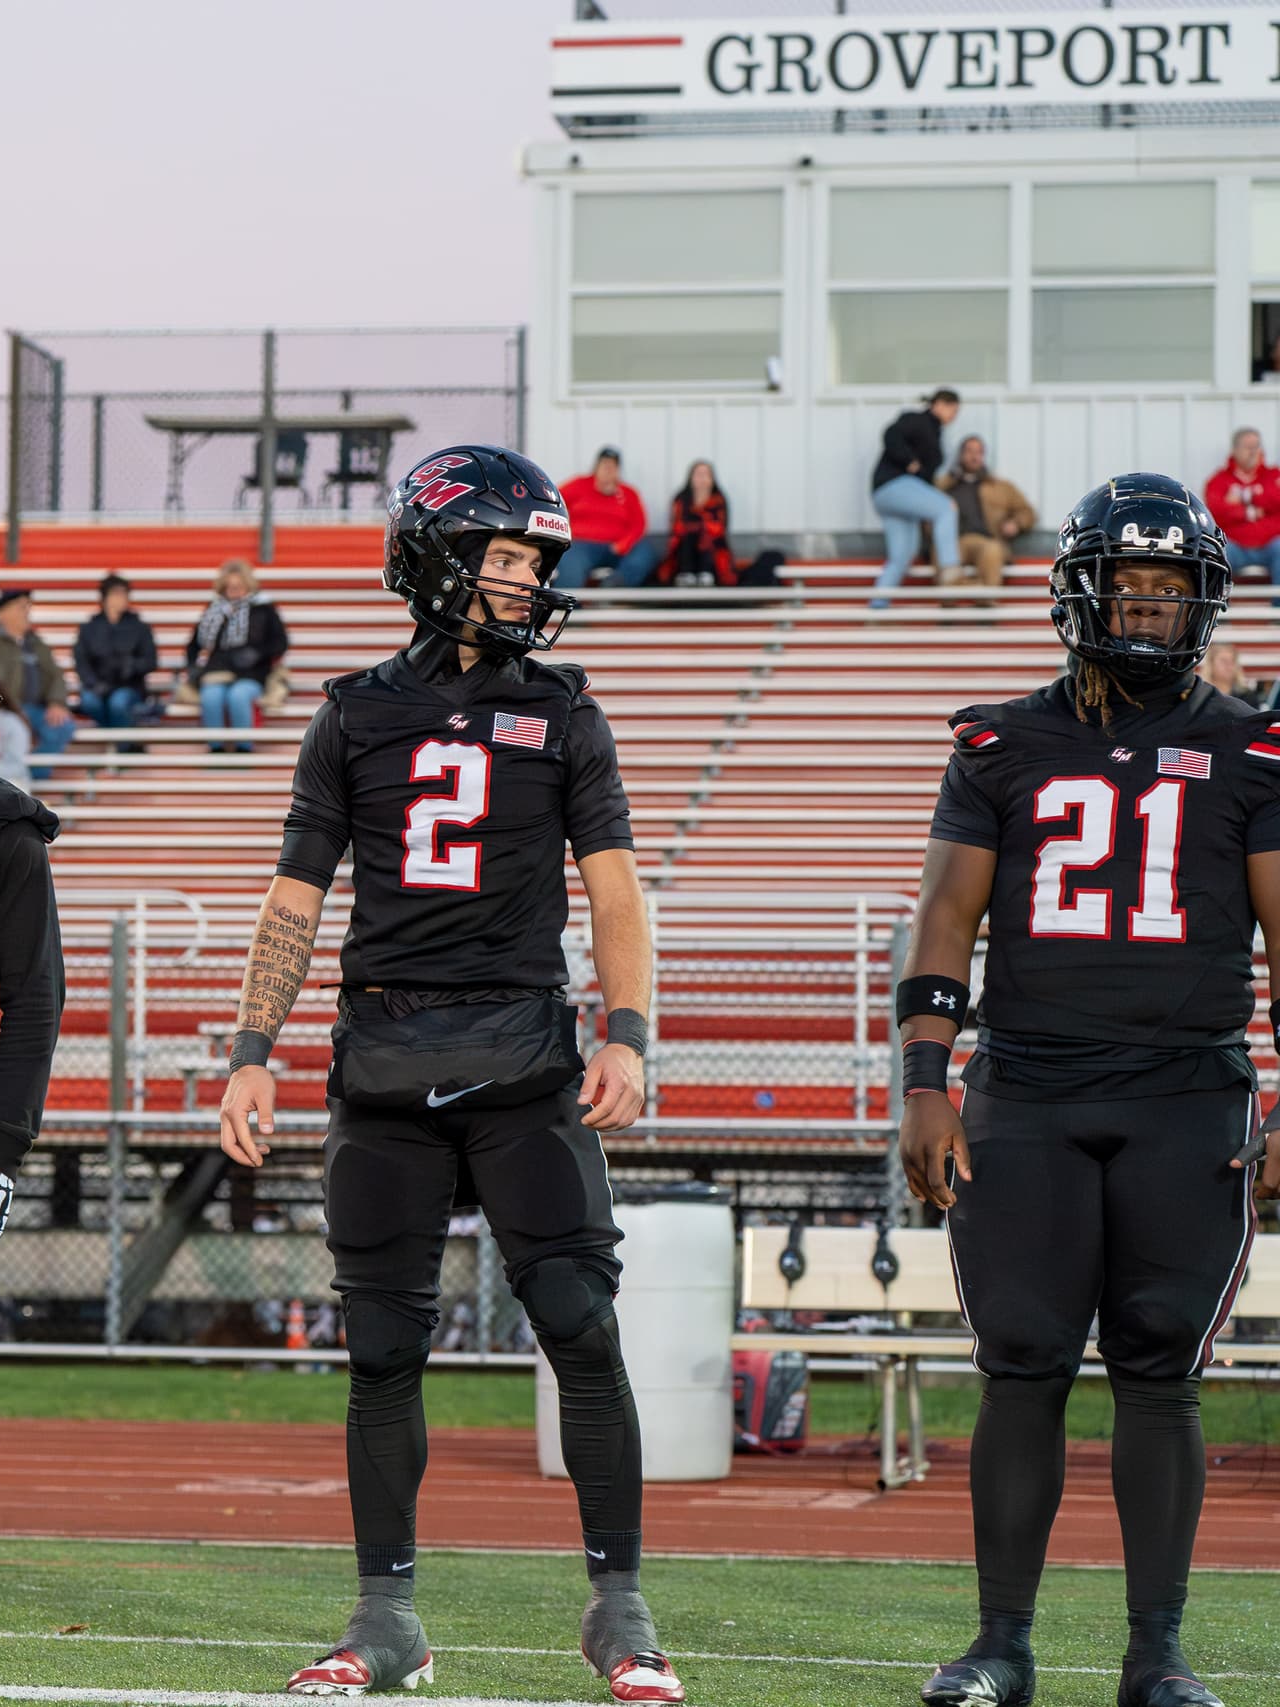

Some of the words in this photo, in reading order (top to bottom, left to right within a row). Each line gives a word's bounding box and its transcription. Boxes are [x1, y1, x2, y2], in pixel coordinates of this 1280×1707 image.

[705, 22, 1231, 95] GROVEPORT
[406, 454, 477, 511] GM
[401, 738, 493, 892] 2
[1030, 774, 1187, 944] 21
